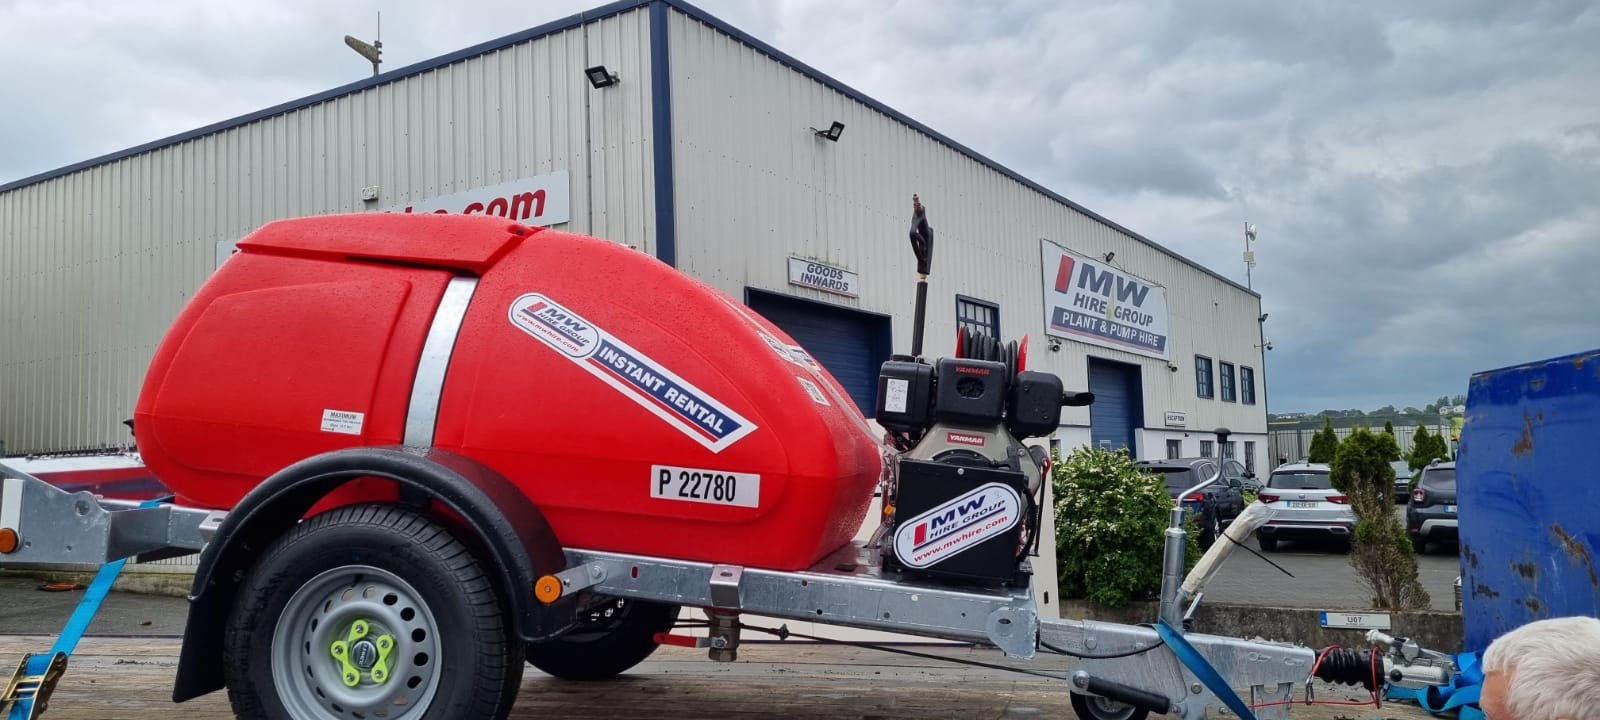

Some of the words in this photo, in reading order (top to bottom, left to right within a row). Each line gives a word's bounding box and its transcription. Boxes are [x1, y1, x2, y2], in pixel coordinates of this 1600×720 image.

[800, 272, 849, 291] INWARDS
[807, 263, 843, 280] GOODS
[1077, 262, 1150, 308] MW
[545, 308, 588, 332] MW
[1073, 292, 1108, 315] HIRE
[1114, 305, 1153, 327] GROUP
[516, 313, 579, 352] www.mwhire.com
[537, 312, 558, 325] HIRE
[559, 325, 590, 344] GROUP
[1062, 311, 1098, 330] PLANT
[1100, 322, 1107, 333] &
[1110, 323, 1137, 340] PUMP
[1139, 332, 1159, 347] HIRE
[955, 366, 990, 376] YANMAR
[598, 346, 665, 392] INSTANT
[664, 387, 724, 433] RENTAL
[949, 434, 983, 444] YANMAR
[659, 469, 671, 495] P
[679, 471, 736, 502] 22780
[930, 521, 959, 539] HIRE
[962, 500, 1005, 523] GROUP
[931, 495, 986, 530] MW
[914, 515, 1008, 562] www.mwhire.com
